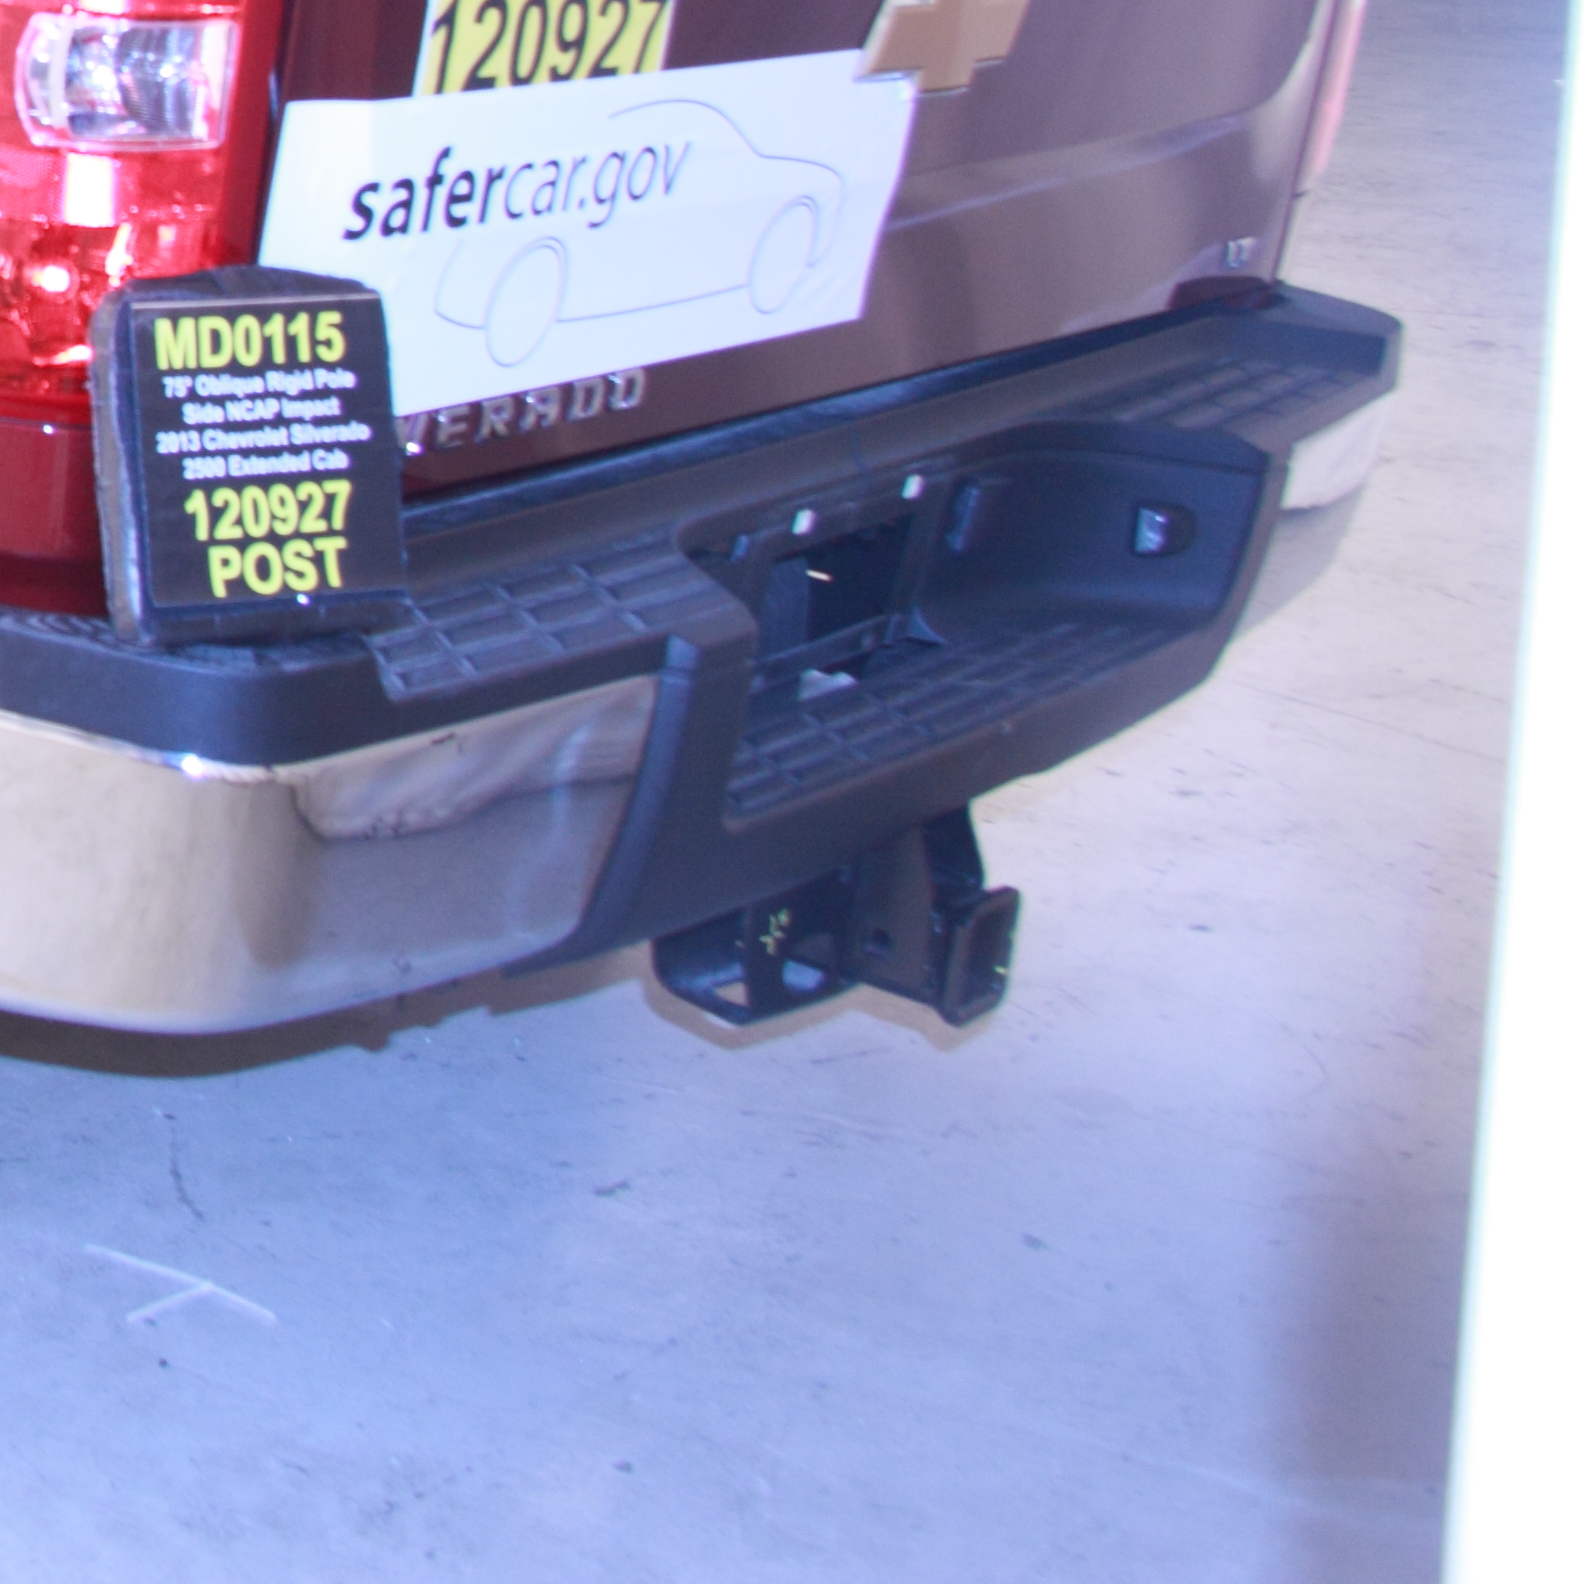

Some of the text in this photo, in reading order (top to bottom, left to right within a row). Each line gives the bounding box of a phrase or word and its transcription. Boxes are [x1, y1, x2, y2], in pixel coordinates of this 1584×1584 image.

[342, 140, 692, 242] safercar.gov
[153, 310, 346, 372] MD0115
[195, 371, 265, 400] Oblique
[266, 370, 315, 397] Rigid
[316, 367, 357, 391] Pole
[182, 395, 342, 425] Side NCAP Impact
[156, 419, 373, 454] 2013 Chevrolet Silverado
[181, 446, 351, 481] 2500 Extended Cab
[183, 479, 353, 542] 120927
[207, 536, 348, 598] POST
